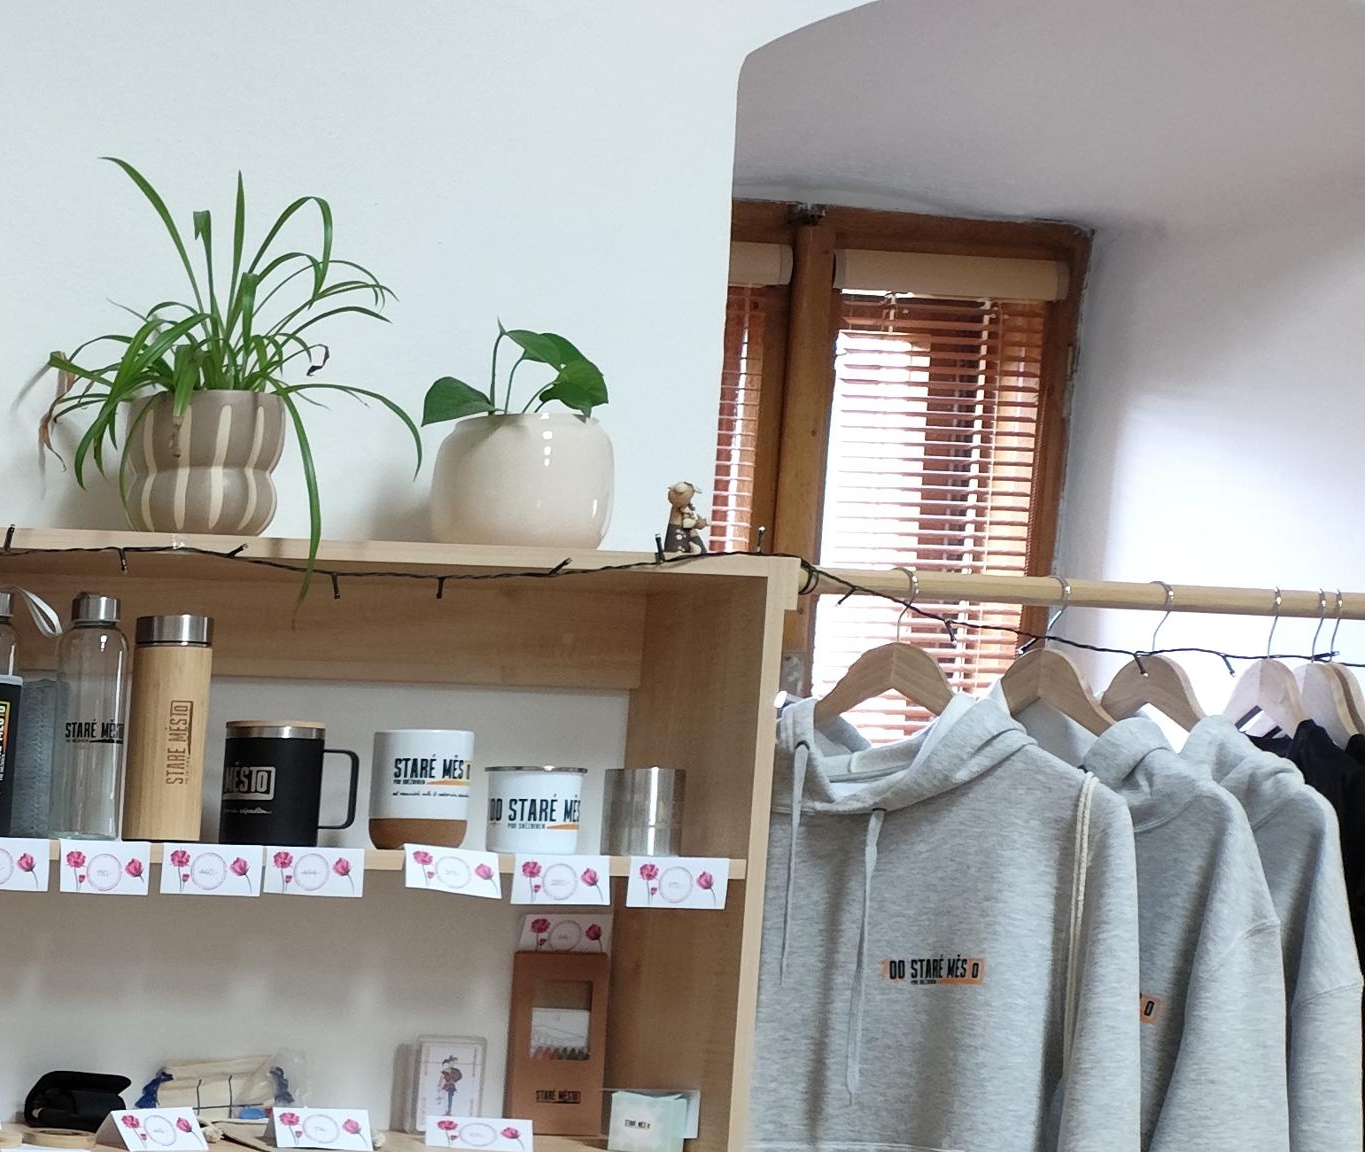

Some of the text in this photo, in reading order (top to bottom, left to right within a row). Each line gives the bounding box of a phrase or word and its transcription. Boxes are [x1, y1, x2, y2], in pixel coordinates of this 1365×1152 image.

[65, 719, 97, 738] STARÉ
[394, 753, 436, 778] STARÉ
[508, 793, 558, 822] STARÉ
[911, 954, 945, 978] STARÉ
